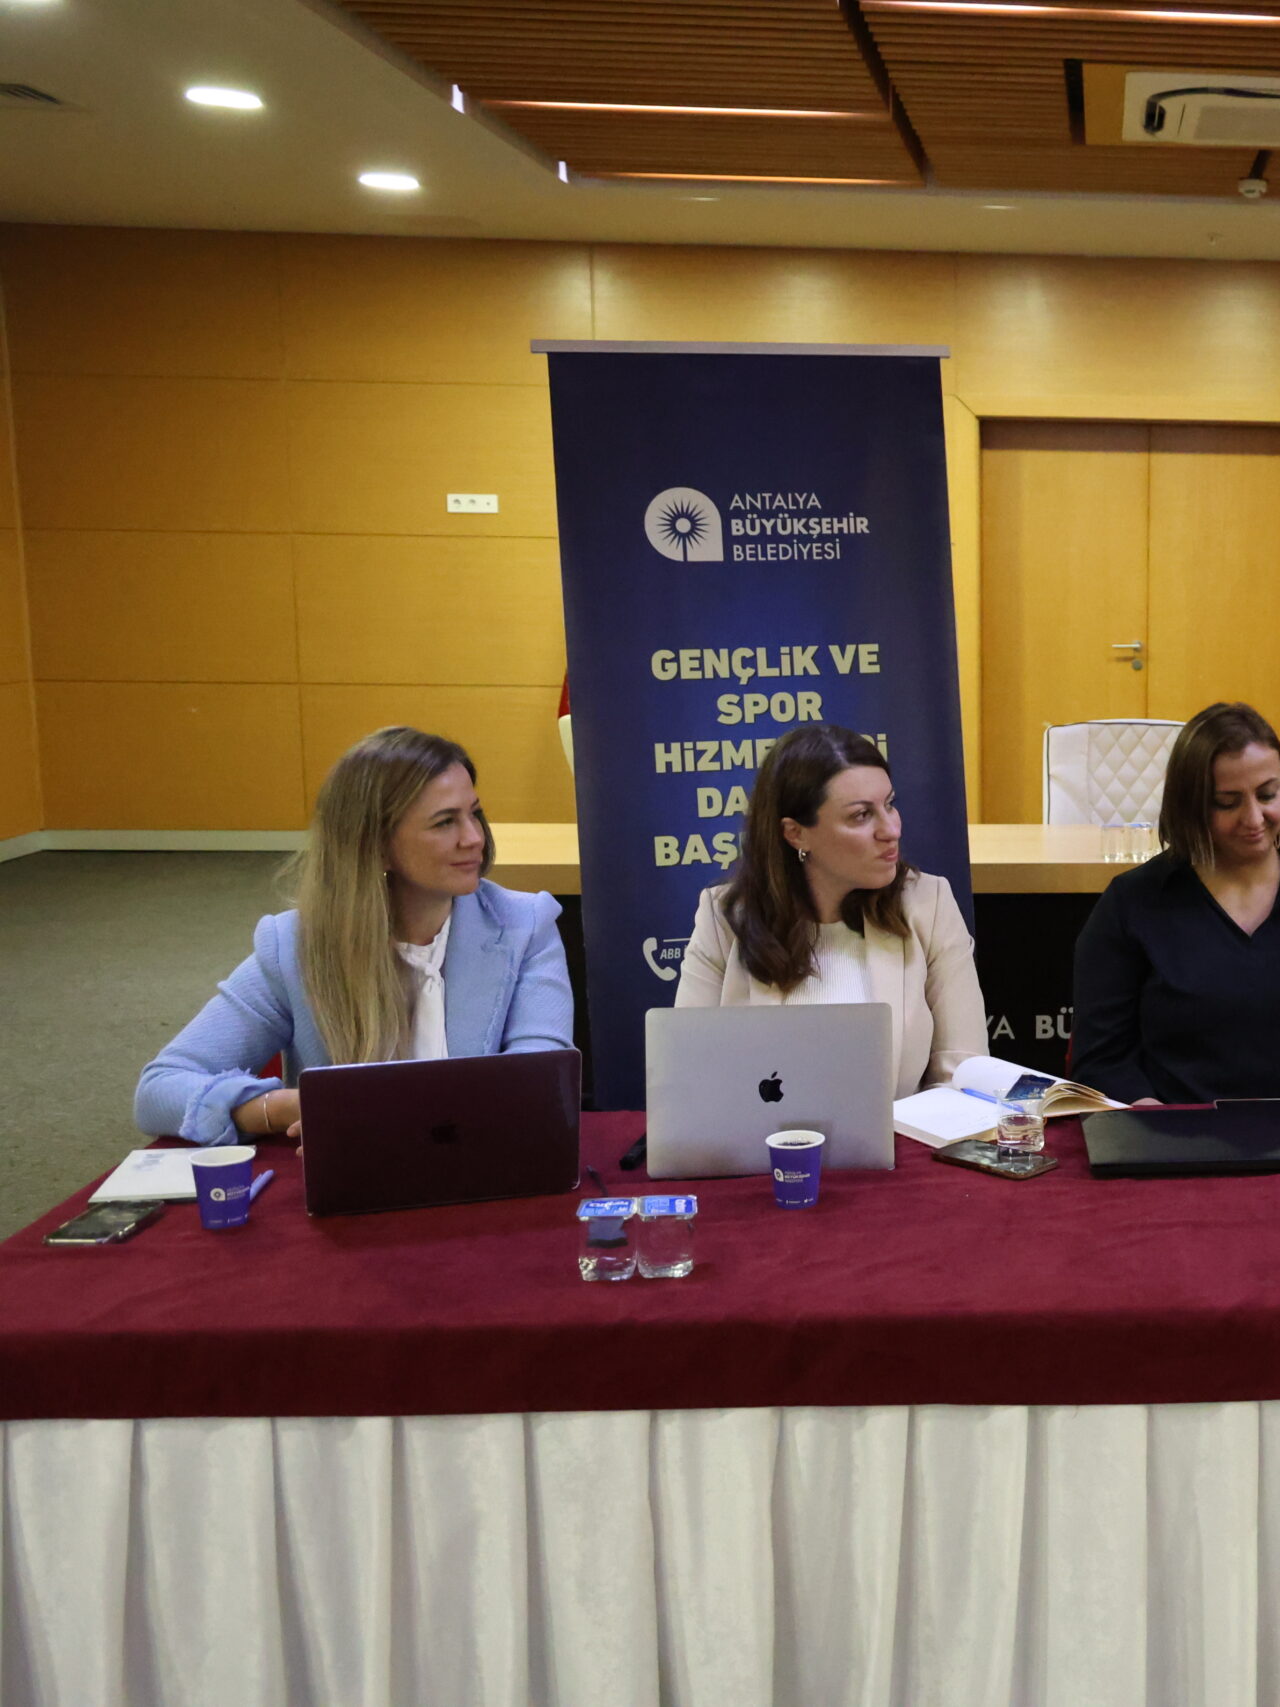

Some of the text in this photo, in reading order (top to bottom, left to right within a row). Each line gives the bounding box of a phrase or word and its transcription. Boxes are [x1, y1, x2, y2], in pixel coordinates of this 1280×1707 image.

[729, 492, 822, 511] ANTALYA
[731, 512, 870, 538] BÜYÜKŞEHİR
[732, 538, 841, 562] BELEDİYESİ
[828, 643, 881, 675] VE
[716, 691, 824, 725] SPOR
[660, 947, 681, 960] ABB
